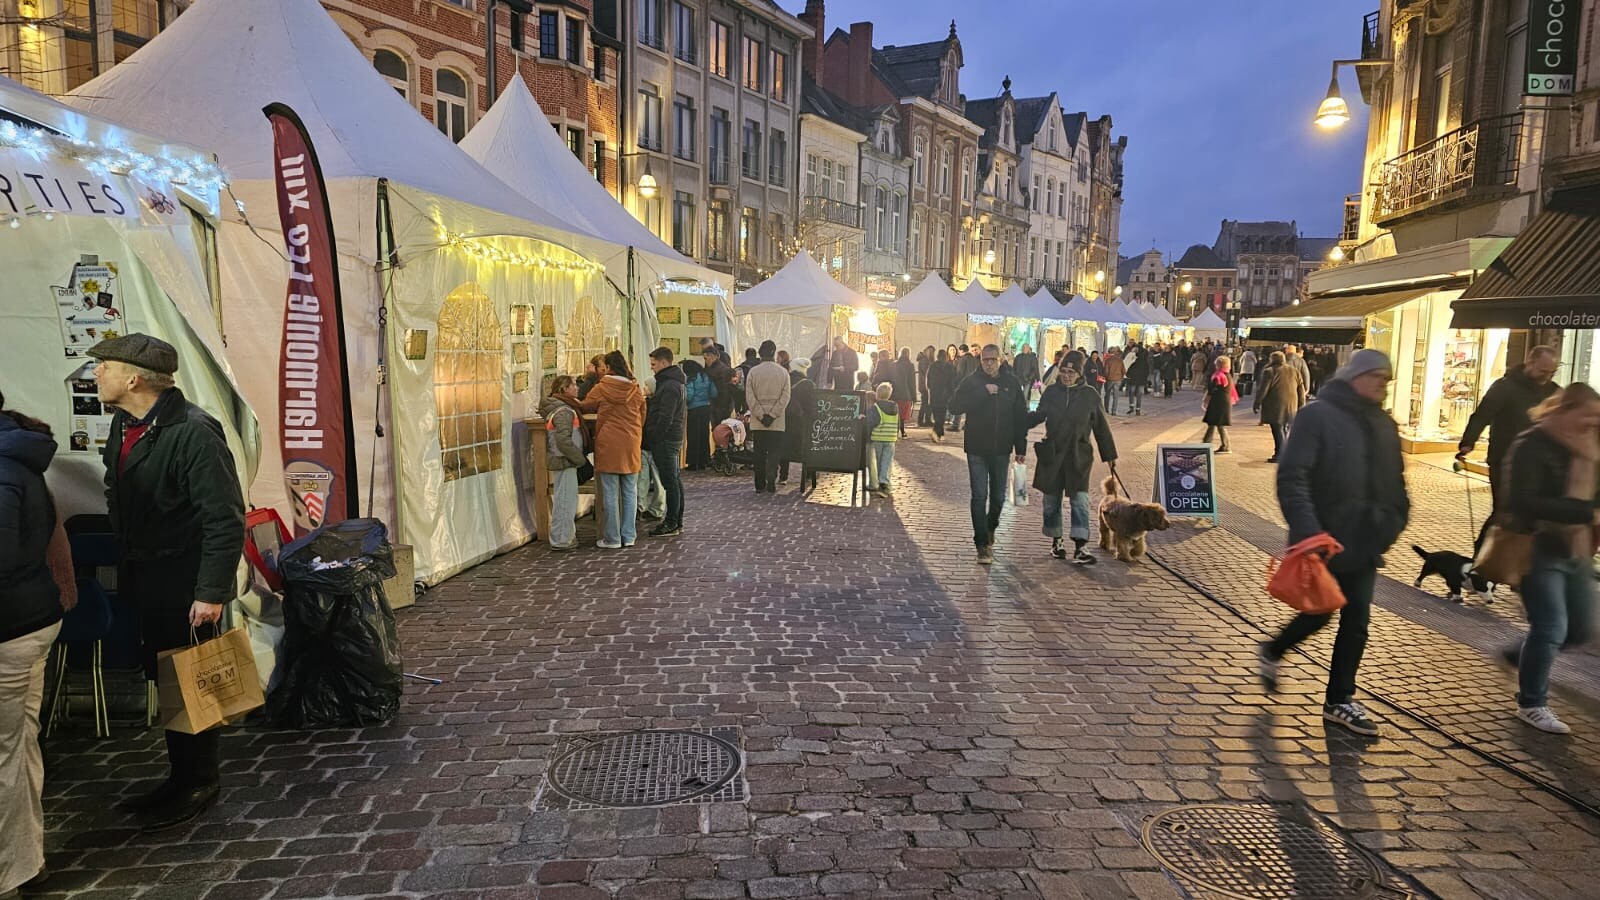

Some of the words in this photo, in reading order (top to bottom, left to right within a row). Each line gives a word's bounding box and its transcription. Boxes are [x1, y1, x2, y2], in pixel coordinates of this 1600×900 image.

[1536, 0, 1566, 68] choc
[1530, 78, 1570, 90] DOM
[1170, 497, 1210, 509] OPEN
[197, 666, 236, 690] DOM
